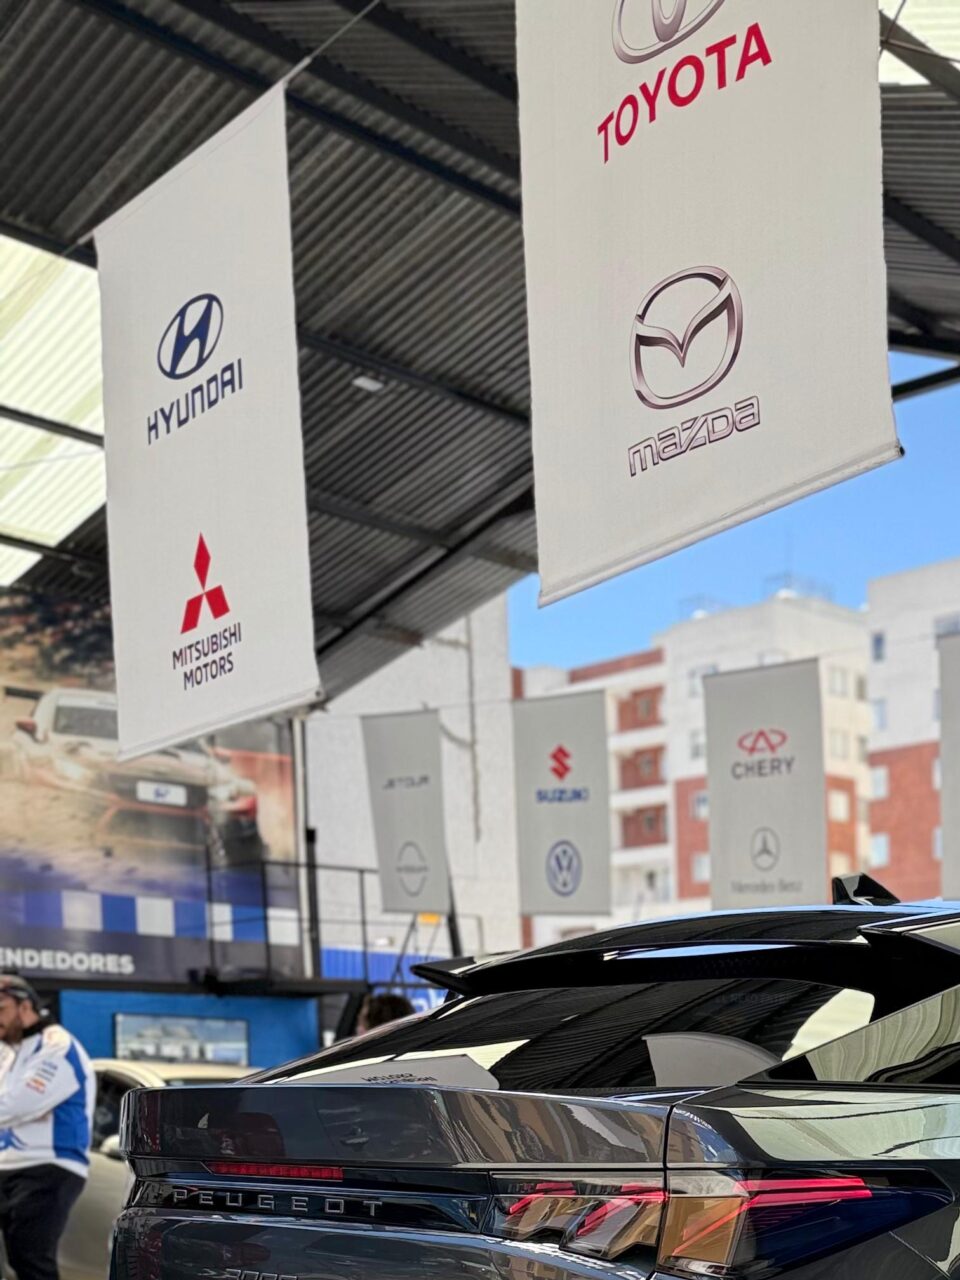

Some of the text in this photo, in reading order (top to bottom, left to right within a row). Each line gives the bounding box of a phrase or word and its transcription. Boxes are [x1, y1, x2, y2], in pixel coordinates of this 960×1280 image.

[597, 22, 773, 164] TOYOTA
[146, 358, 244, 445] HYUNDAI
[172, 622, 242, 670] MITSUBISHI
[183, 652, 235, 690] MOTORS
[731, 757, 796, 781] CHERY
[535, 787, 589, 803] SUZUKI
[173, 1188, 383, 1217] PEUGEOT
